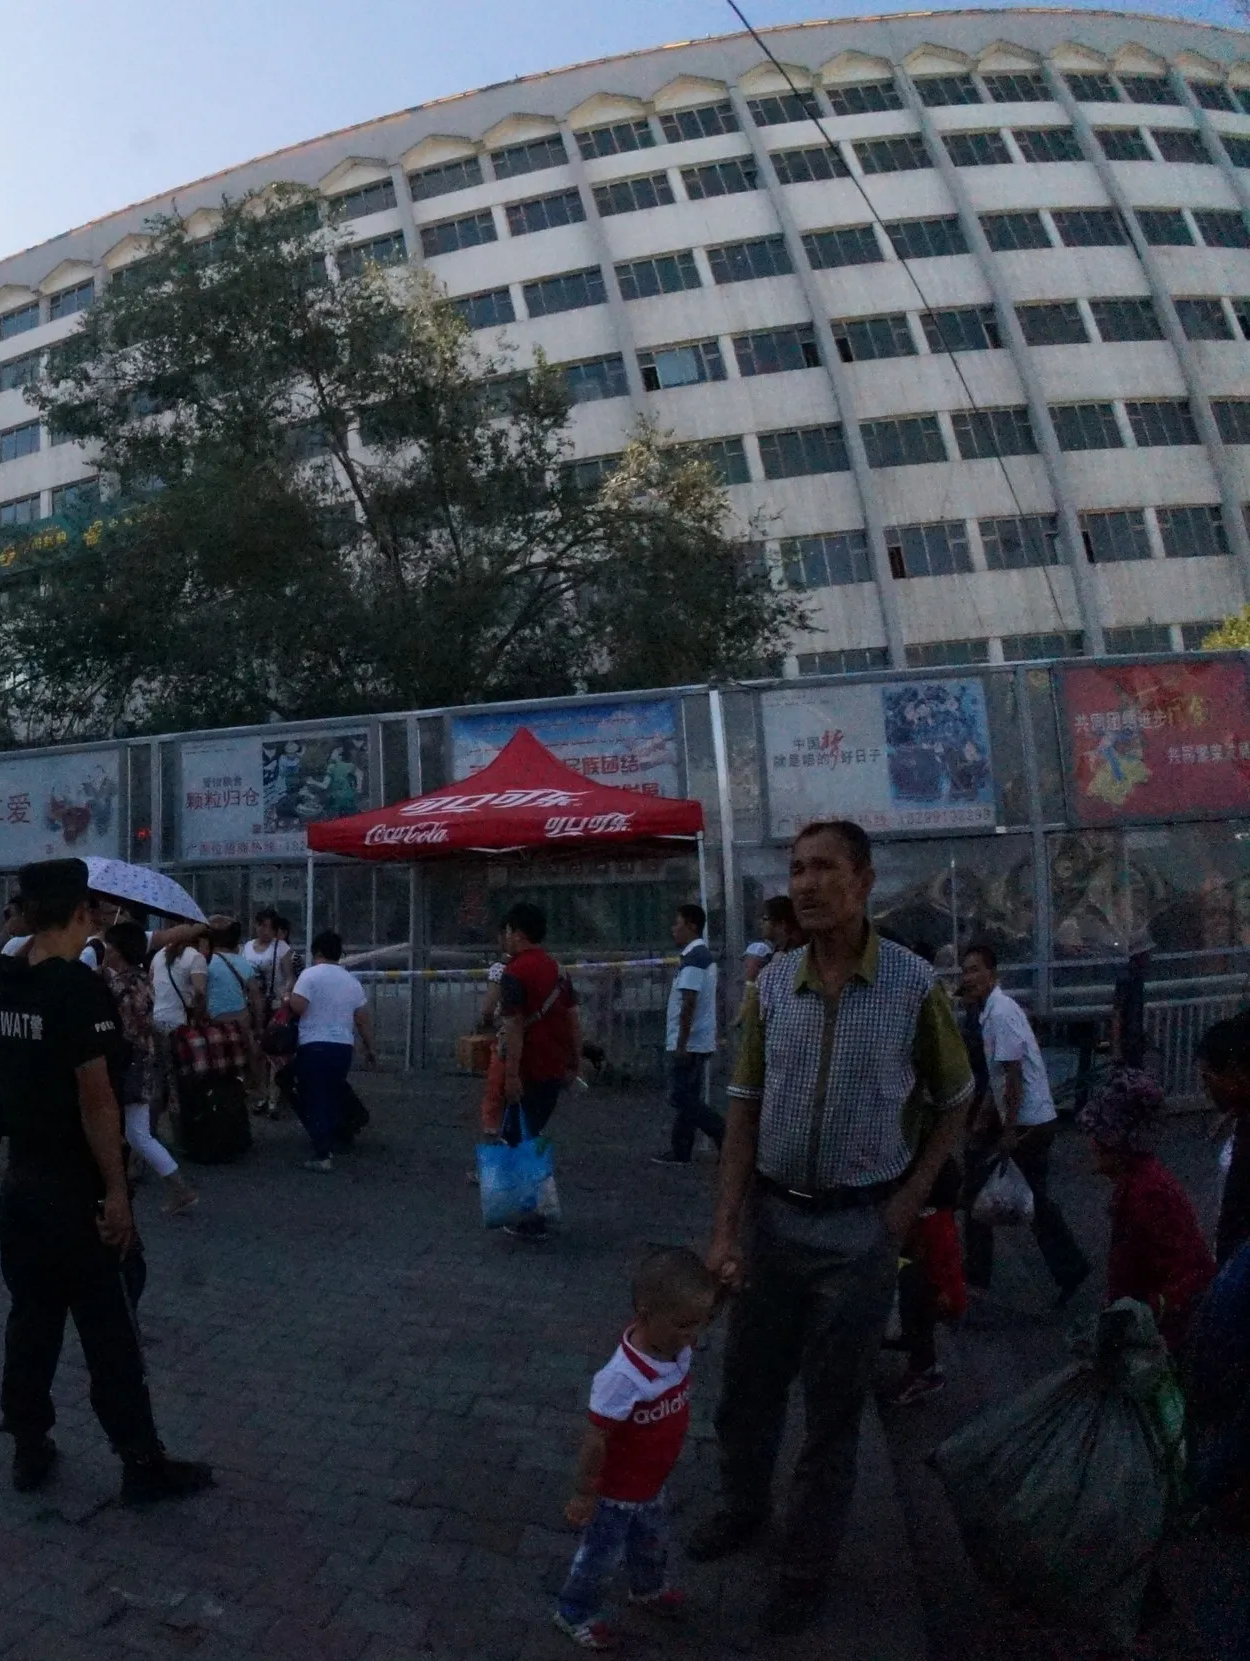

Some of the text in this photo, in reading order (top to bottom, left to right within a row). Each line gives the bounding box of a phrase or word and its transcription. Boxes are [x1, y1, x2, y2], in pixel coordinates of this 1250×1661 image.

[398, 788, 593, 816] 可口可乐
[544, 812, 637, 838] 可口可乐
